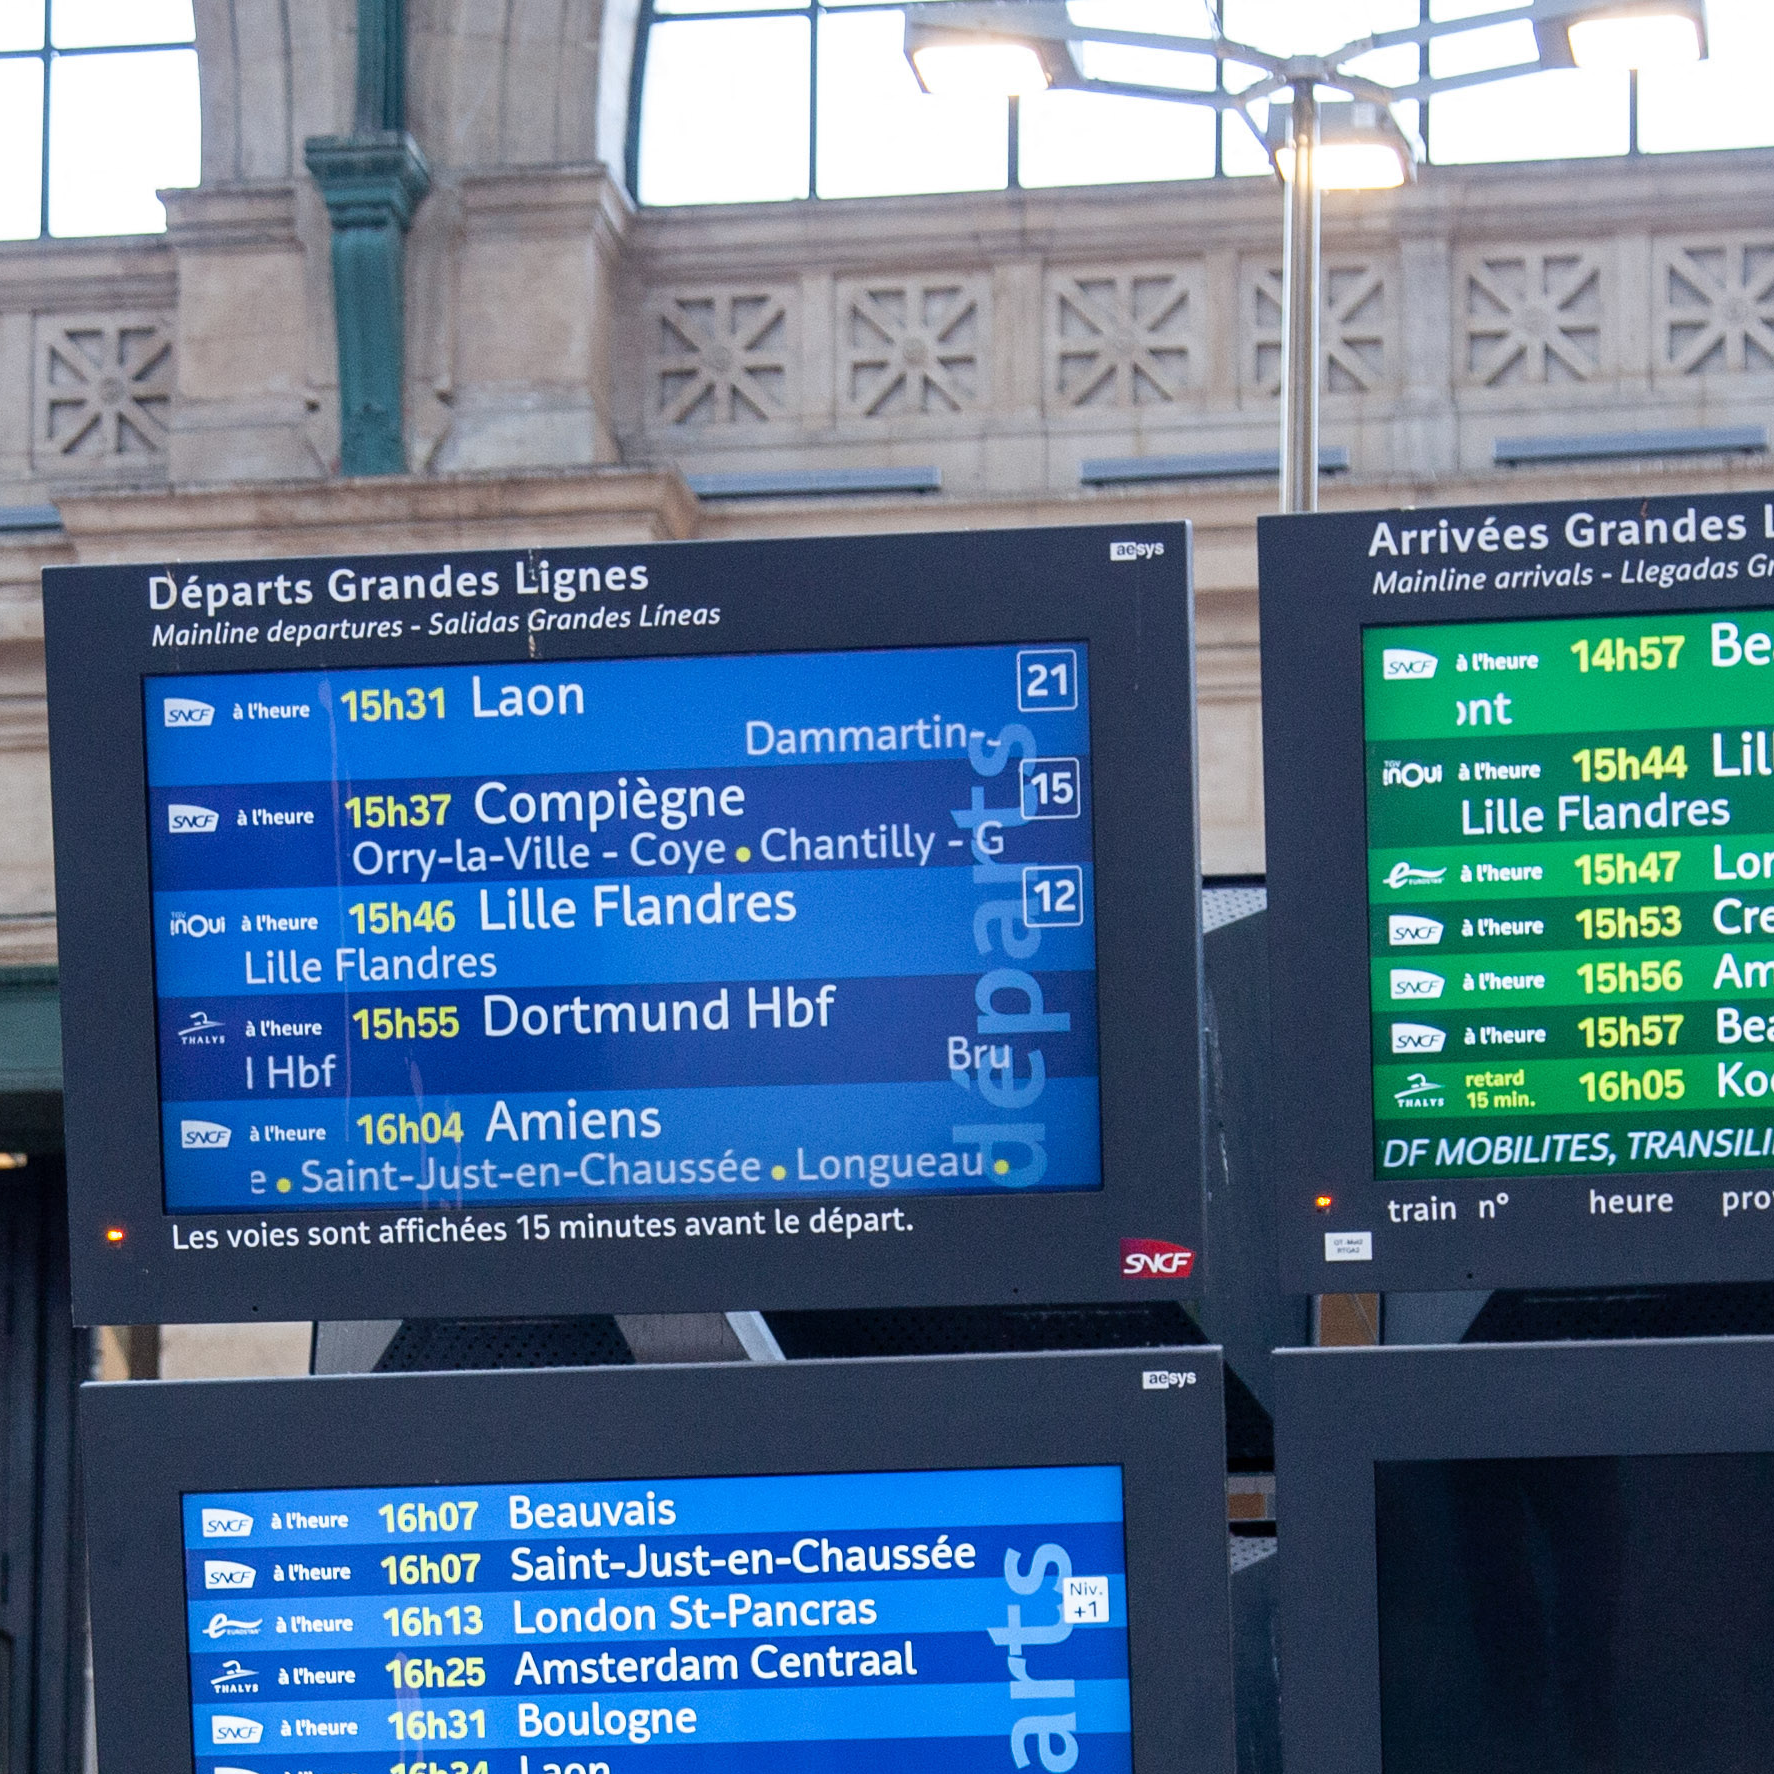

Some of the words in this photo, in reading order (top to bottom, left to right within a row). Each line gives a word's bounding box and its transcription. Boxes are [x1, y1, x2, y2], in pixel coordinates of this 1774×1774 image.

[1111, 541, 1164, 560] aesys
[1369, 516, 1549, 557] Arrivées
[1565, 508, 1747, 548] Grandes
[149, 574, 313, 616] Départs
[328, 565, 499, 603] Grandes
[516, 561, 648, 601] Lignes
[1373, 569, 1486, 595] Mainline
[1495, 563, 1593, 588] arrivals
[1621, 557, 1739, 588] Llegadas
[151, 622, 258, 648] Mainline
[267, 618, 403, 646] departures
[428, 611, 519, 636] Salidas
[529, 608, 631, 632] Grandes
[639, 604, 721, 627] Líneas
[1456, 652, 1468, 672] à
[1473, 650, 1539, 671] l'heure
[1571, 635, 1685, 673] 14h57
[233, 702, 244, 719] à
[248, 701, 310, 719] l'heure
[341, 688, 445, 722] 15h31
[473, 676, 584, 717] Laon
[1028, 664, 1069, 696] 21
[746, 714, 1002, 756] Dammartin-
[1572, 745, 1688, 783] 15h44
[344, 794, 452, 827] 15h37
[475, 775, 744, 832] Compiègne
[1031, 773, 1073, 804] 15
[1462, 797, 1544, 835] Lille
[1559, 792, 1731, 831] Flandres
[353, 834, 589, 882] Orry-la-Ville
[630, 832, 726, 873] Coye
[760, 823, 934, 865] Chantilly
[1574, 850, 1681, 886] 15h47
[349, 900, 455, 934] 15h46
[480, 888, 576, 930] Lille
[594, 883, 796, 926] Flandres
[1034, 880, 1075, 913] 12
[1575, 905, 1682, 940] 15h53
[246, 949, 322, 985] Lille
[336, 945, 496, 982] Flandres
[1576, 959, 1684, 995] 15h56
[353, 1006, 459, 1040] 15h55
[484, 989, 728, 1037] Dortmund
[749, 985, 837, 1029] Hbf
[1577, 1013, 1685, 1049] 15h57
[268, 1054, 336, 1089] Hbf
[1466, 1069, 1525, 1088] retard
[1578, 1068, 1686, 1103] 16h05
[1467, 1092, 1489, 1109] 15
[1493, 1090, 1536, 1108] min.
[356, 1111, 464, 1145] 16h04
[485, 1099, 661, 1143] Amiens
[301, 1150, 762, 1193] Saint-Just-en-Chaussée
[797, 1147, 984, 1189] Longueau
[1435, 1133, 1618, 1167] MOBILITES,
[1388, 1195, 1456, 1224] train
[1479, 1192, 1509, 1219] n°
[1590, 1189, 1674, 1215] heure
[173, 1224, 218, 1250] Les
[228, 1221, 299, 1248] voies
[307, 1219, 370, 1246] sont
[379, 1212, 507, 1245] affichées
[517, 1215, 550, 1241] 15
[560, 1210, 676, 1240] minutes
[684, 1211, 766, 1237] avant
[774, 1208, 801, 1235] le
[808, 1206, 914, 1239] départ.
[1143, 1371, 1196, 1389] aesys
[379, 1501, 479, 1534] 16h07
[509, 1491, 677, 1531] Beauvais
[381, 1552, 481, 1586] 16h07
[511, 1534, 976, 1583] Saint-Just-en-Chaussée
[1070, 1580, 1104, 1596] Niv.
[383, 1605, 483, 1637] 16h13
[514, 1597, 657, 1637] London
[669, 1592, 876, 1631] St-Pancras
[1073, 1601, 1098, 1618] +1
[385, 1657, 486, 1689] 16h25
[515, 1646, 738, 1688] Amsterdam
[750, 1641, 917, 1681] Centraal
